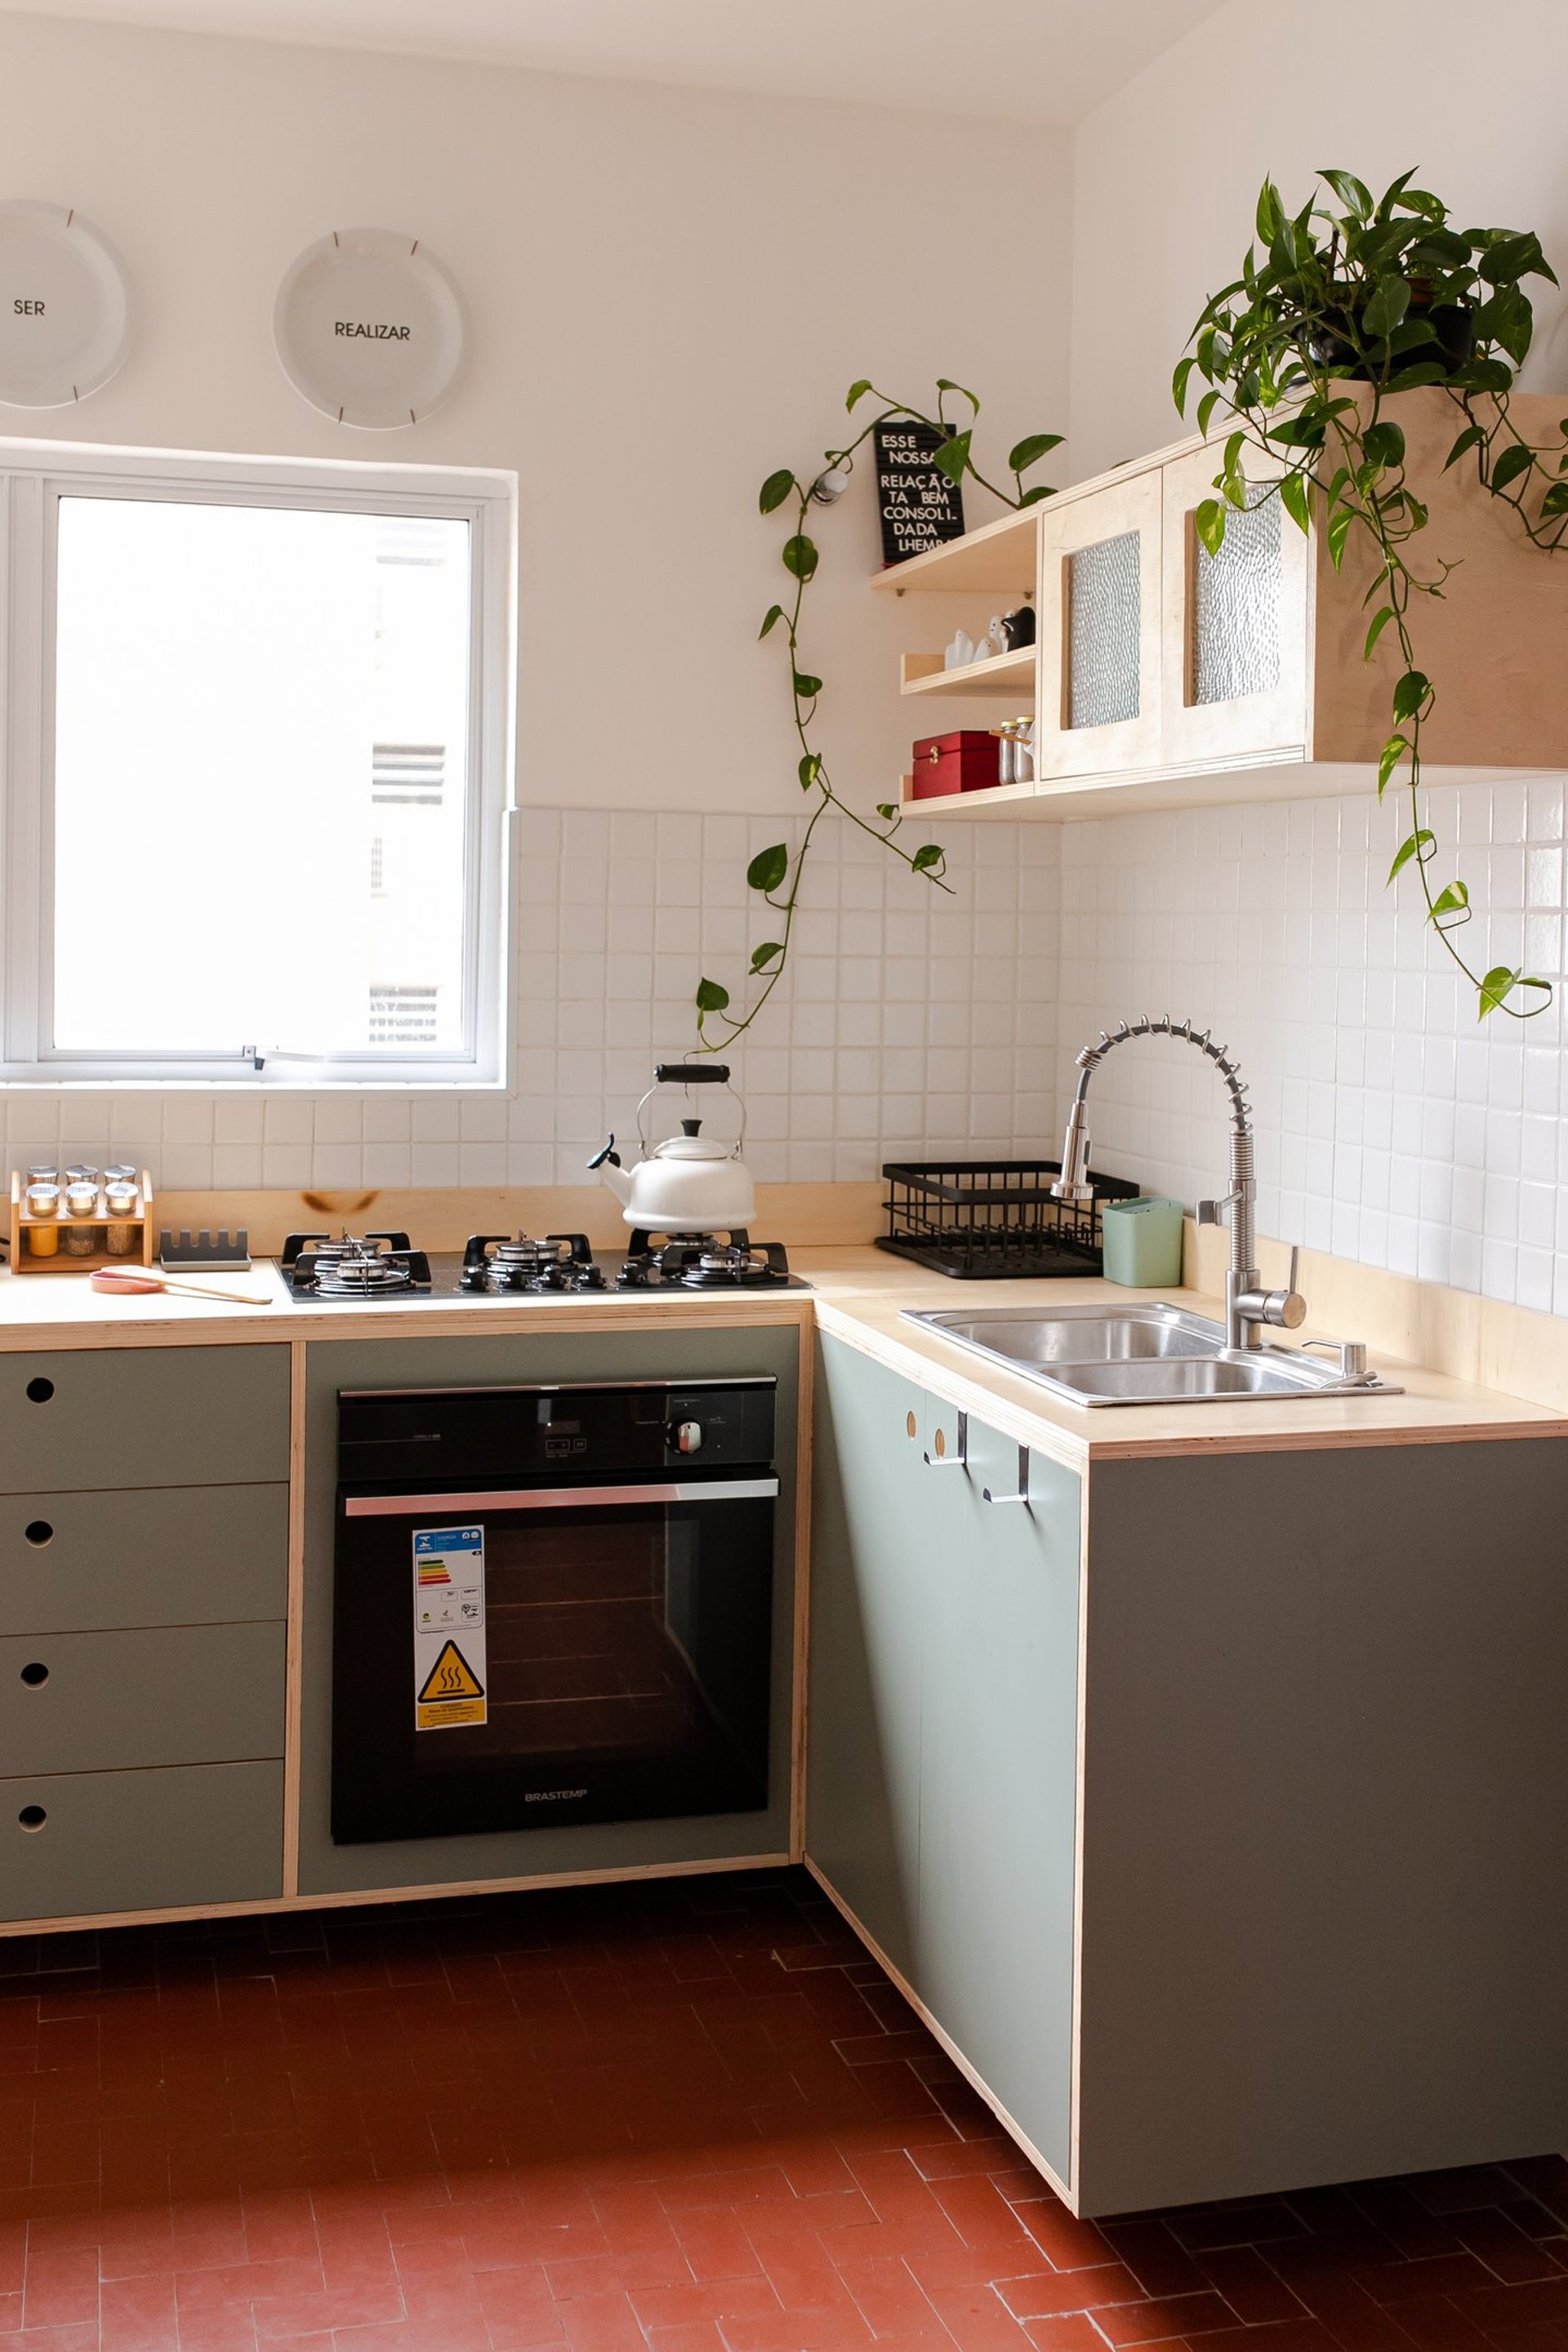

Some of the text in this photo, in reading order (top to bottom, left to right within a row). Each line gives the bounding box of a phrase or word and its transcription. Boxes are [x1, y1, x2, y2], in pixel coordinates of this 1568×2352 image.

[13, 299, 46, 316] SER
[334, 321, 411, 341] REALIZAR
[881, 434, 916, 448] ESSE
[889, 491, 949, 505] TA BEM
[893, 523, 938, 536] DADA
[524, 1789, 588, 1802] BRASTEMP
